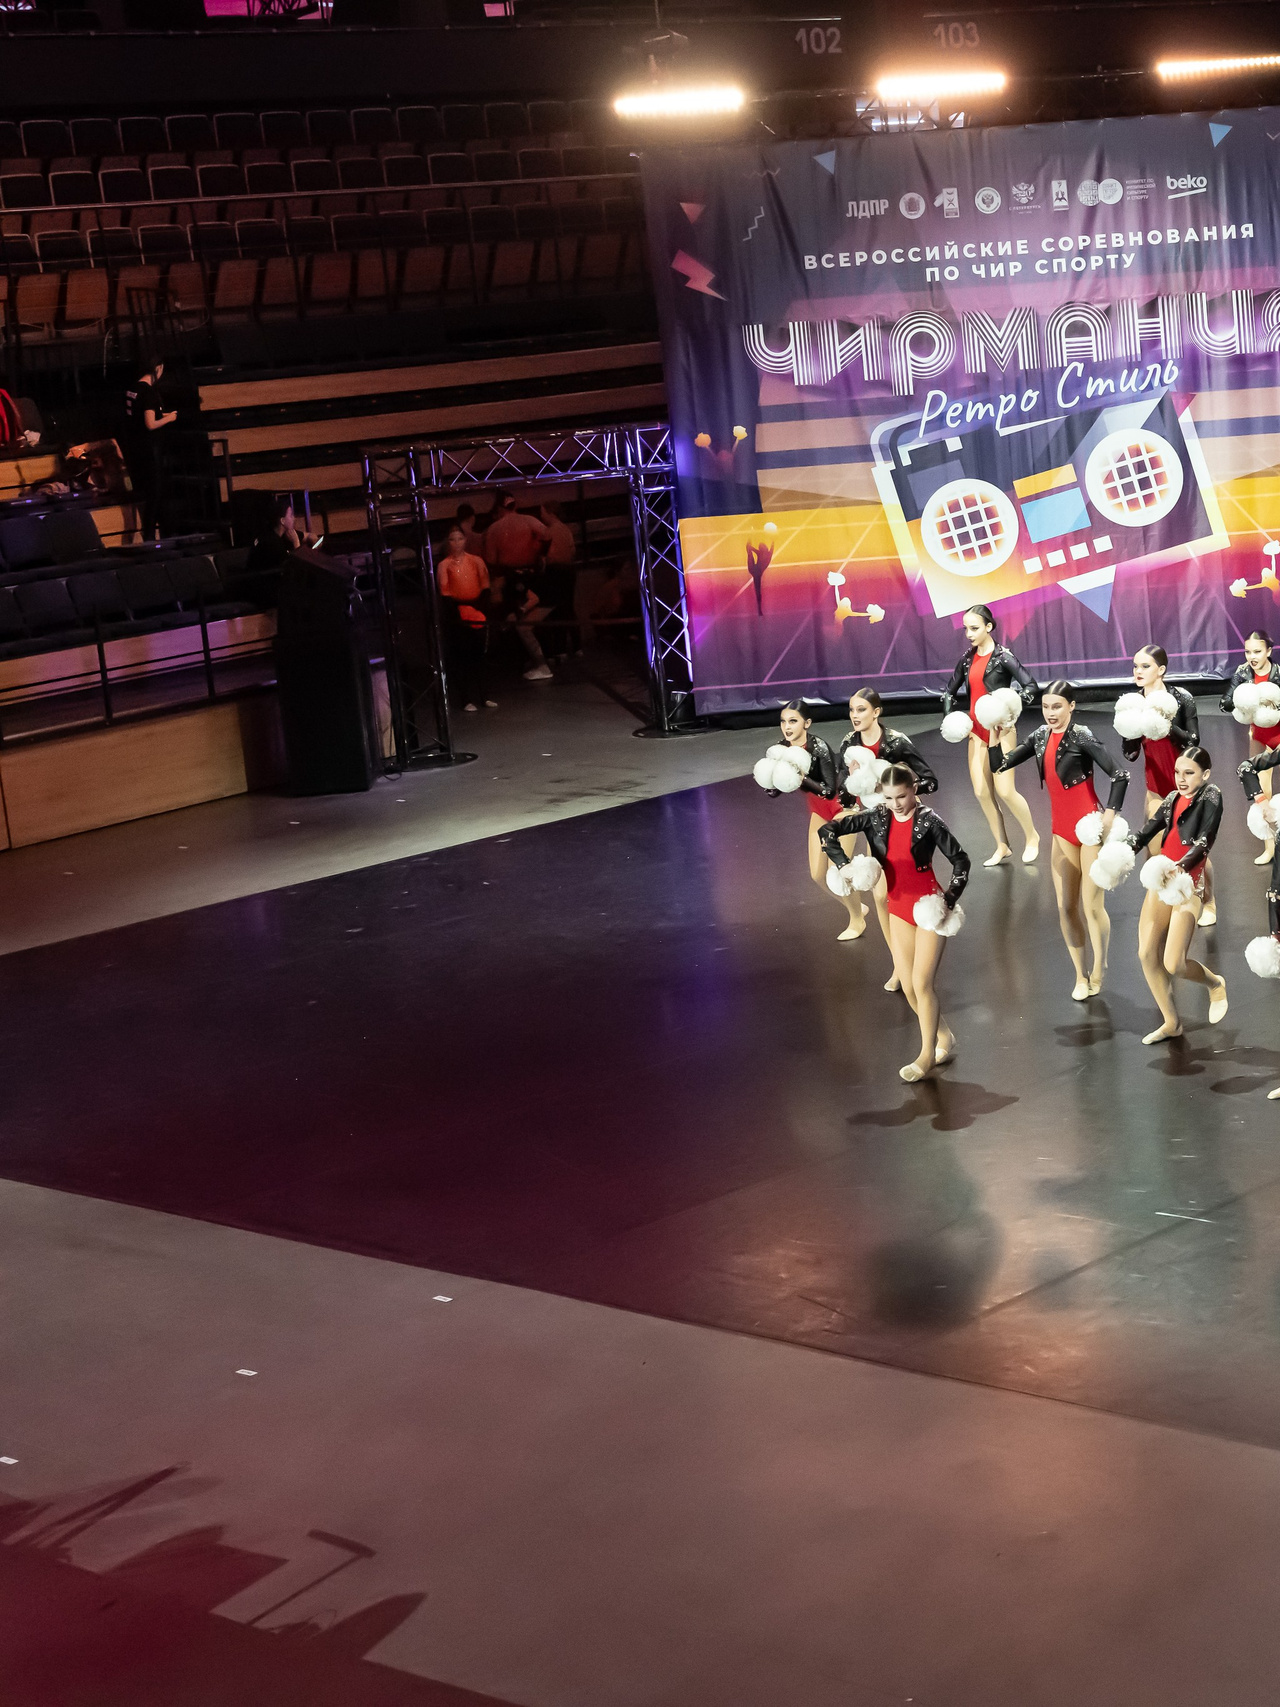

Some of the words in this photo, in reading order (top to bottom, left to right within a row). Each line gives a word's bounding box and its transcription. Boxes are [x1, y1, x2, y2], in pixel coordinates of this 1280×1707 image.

[795, 27, 843, 54] 102
[933, 21, 980, 48] 103
[1166, 175, 1208, 190] beko
[846, 199, 889, 219] ЛДПР
[804, 240, 1029, 270] ВСЕРОССИЙСКИЕ
[1041, 223, 1255, 253] СОРЕВНОВАНИЯ
[926, 266, 960, 282] ПО
[972, 261, 1023, 279] ЧИР
[1035, 253, 1136, 274] СПОРТУ
[919, 388, 1040, 438] Ретро
[1056, 360, 1179, 409] Стиль
